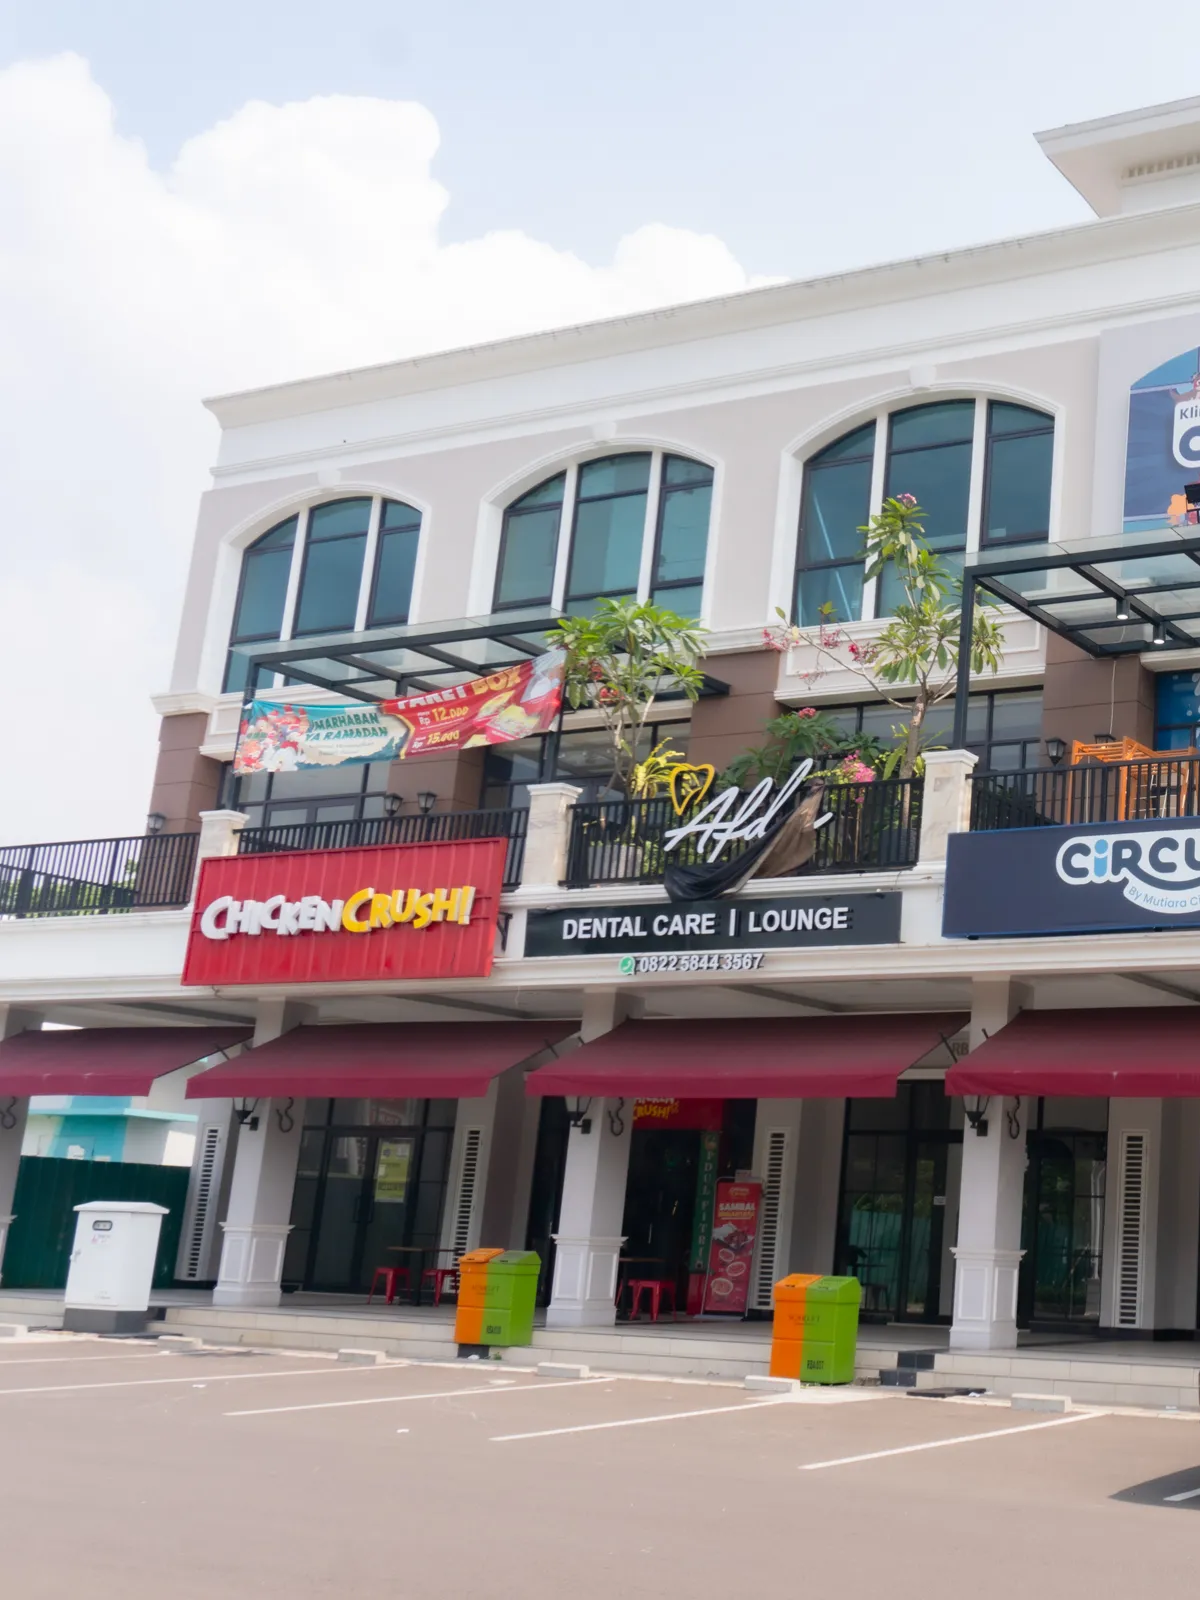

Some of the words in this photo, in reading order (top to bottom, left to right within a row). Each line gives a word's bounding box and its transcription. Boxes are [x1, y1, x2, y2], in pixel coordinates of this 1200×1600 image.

[312, 712, 381, 731] MARHABAN
[323, 726, 389, 741] RAMADAN
[1128, 885, 1142, 901] By
[1143, 893, 1188, 909] Mutiara
[201, 894, 345, 940] CHICKEN
[342, 886, 476, 933] CRUSH!
[562, 915, 647, 940] DENTAL
[652, 913, 717, 937] CARE
[748, 906, 851, 933] LOUNGE
[639, 956, 678, 972] 0822
[680, 954, 720, 971] 5844
[722, 953, 764, 970] 3567
